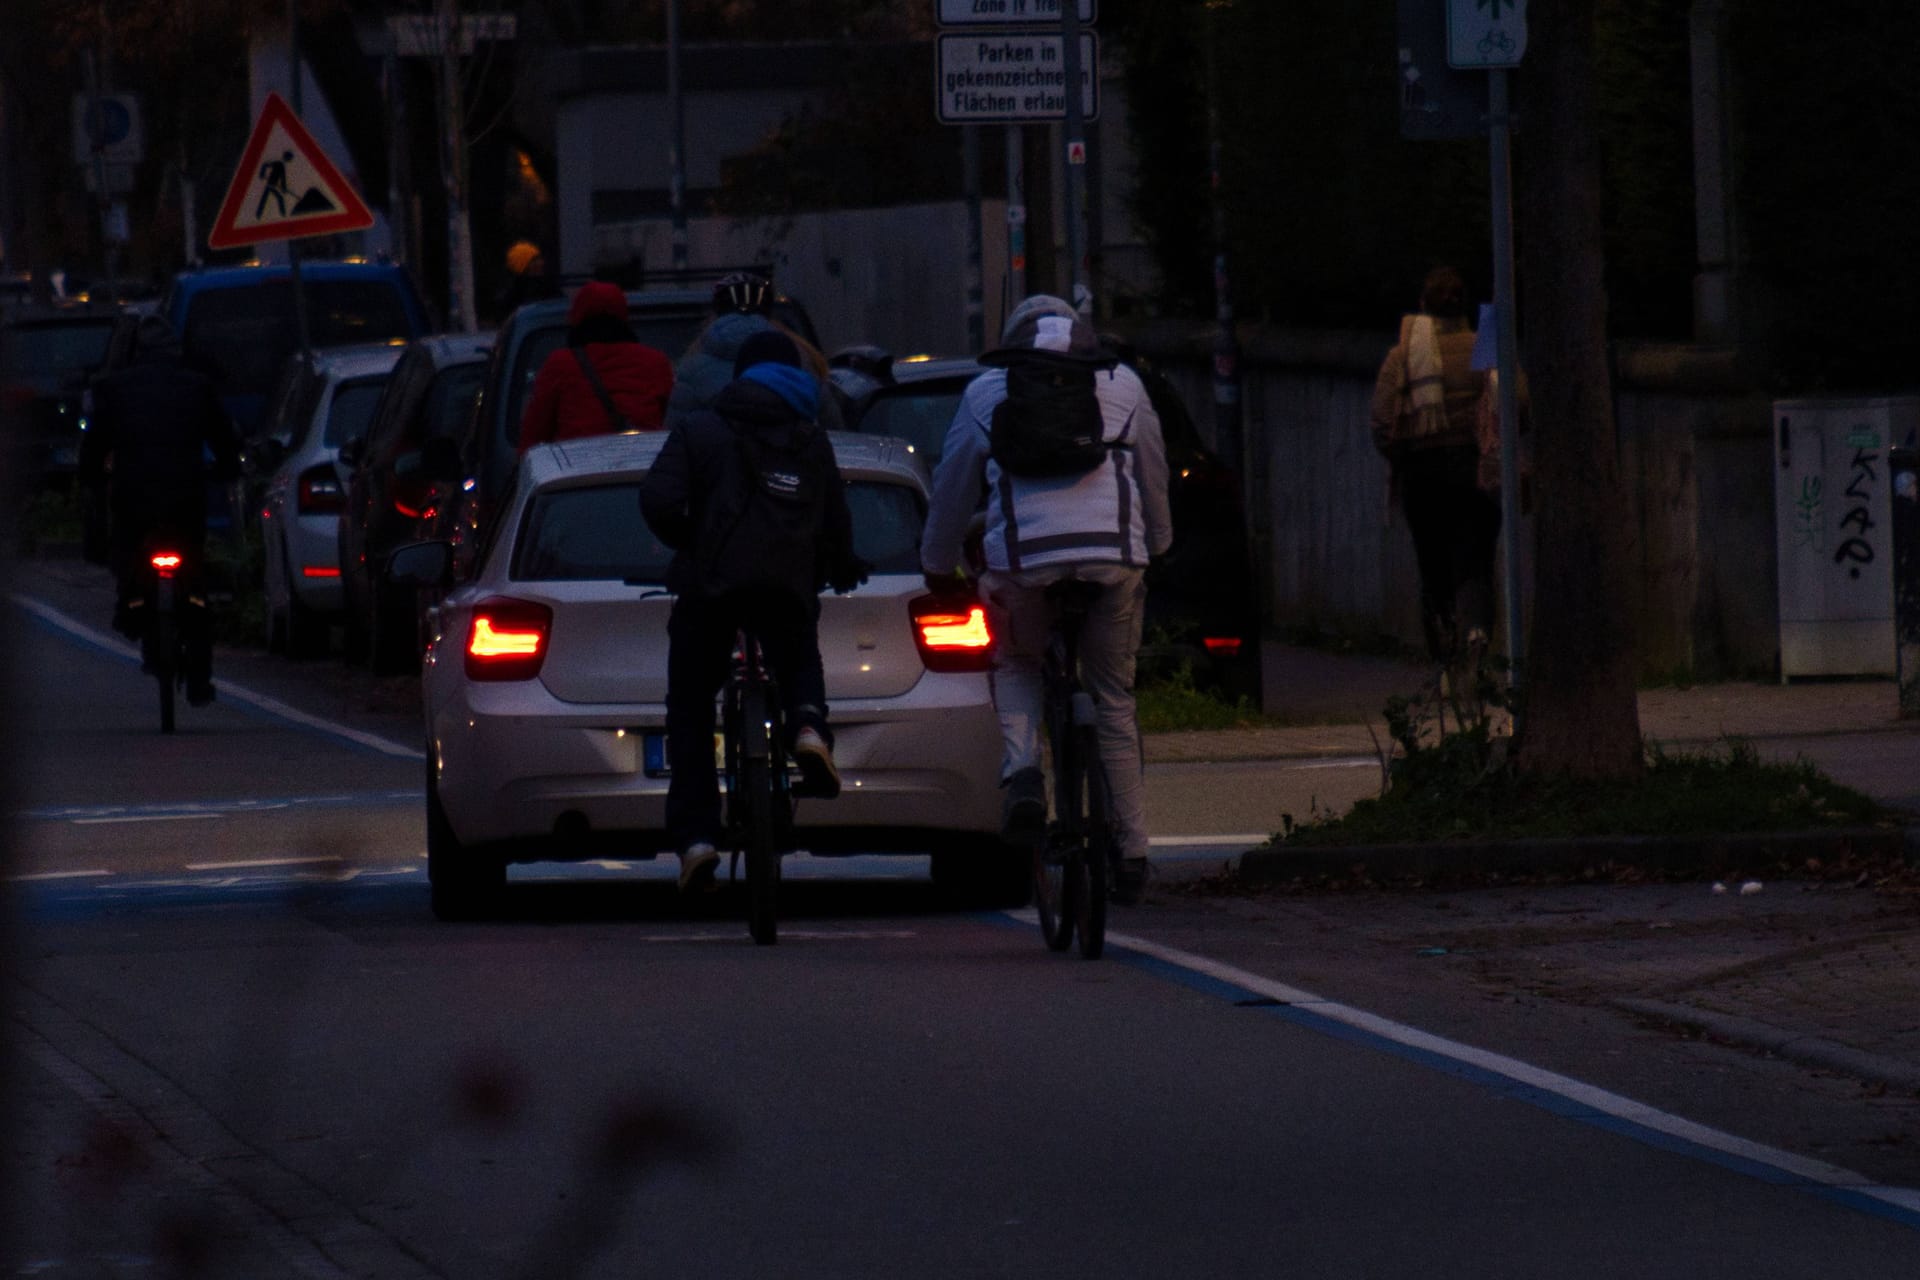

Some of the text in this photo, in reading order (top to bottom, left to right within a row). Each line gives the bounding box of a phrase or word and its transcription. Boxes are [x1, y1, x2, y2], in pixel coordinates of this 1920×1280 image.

[971, 0, 1006, 14] Zone
[978, 41, 1056, 62] Parken in
[946, 67, 1089, 92] gekennzeichnen
[954, 92, 1016, 112] Flächen
